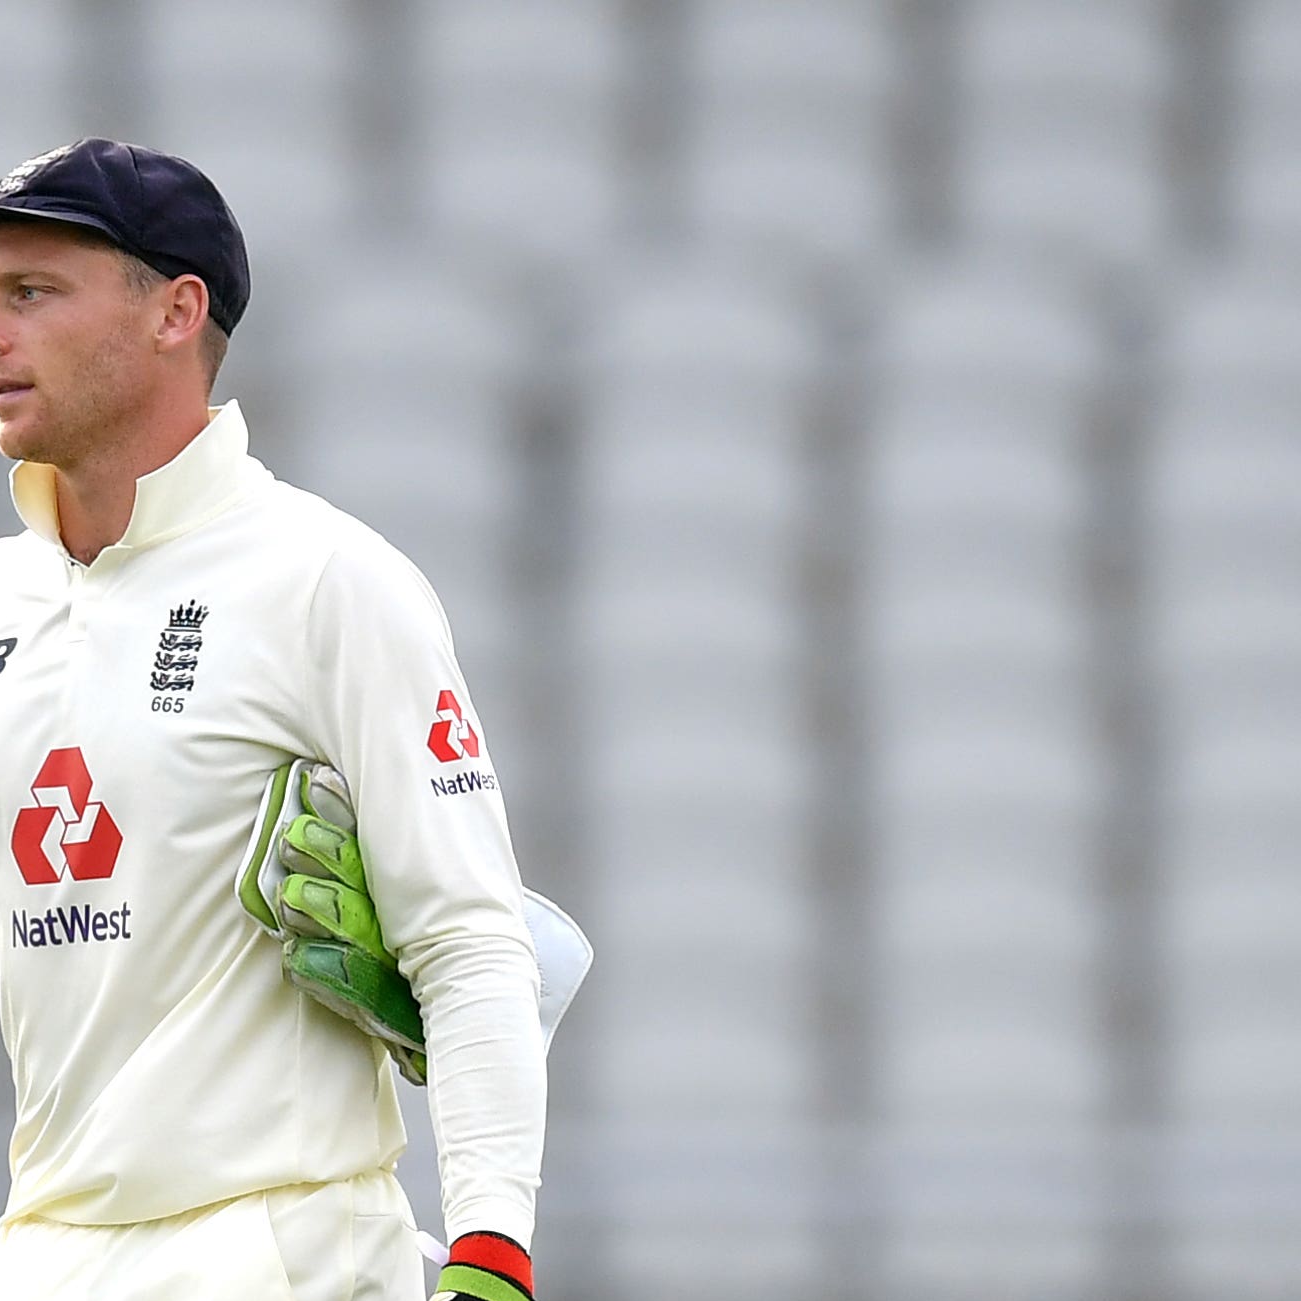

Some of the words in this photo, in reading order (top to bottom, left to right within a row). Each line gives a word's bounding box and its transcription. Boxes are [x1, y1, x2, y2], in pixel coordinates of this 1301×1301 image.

[151, 696, 185, 713] 665
[430, 770, 499, 797] NatWes
[12, 901, 131, 948] NatWest
